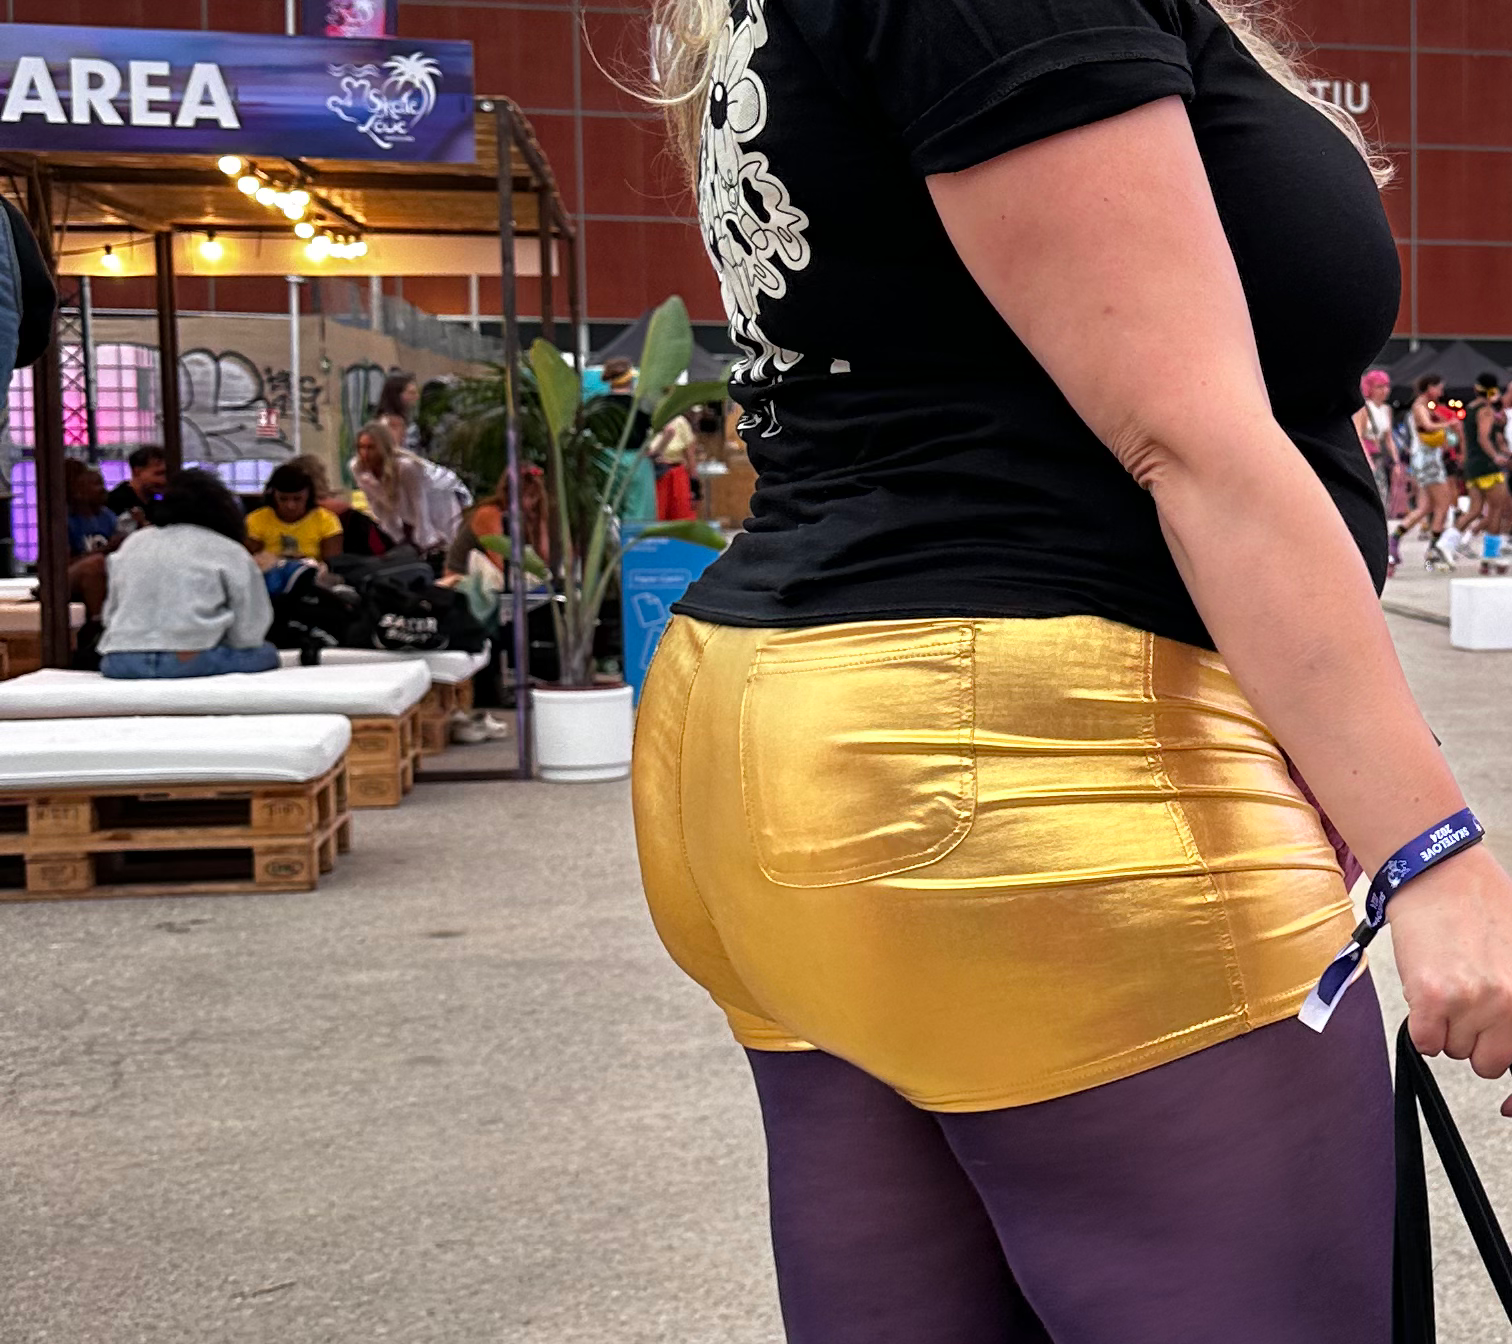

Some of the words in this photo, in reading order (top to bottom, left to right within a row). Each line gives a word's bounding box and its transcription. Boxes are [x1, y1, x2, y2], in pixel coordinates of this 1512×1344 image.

[1, 56, 242, 130] AREA
[1419, 826, 1470, 862] SKATELOVE
[1429, 823, 1454, 843] 2024
